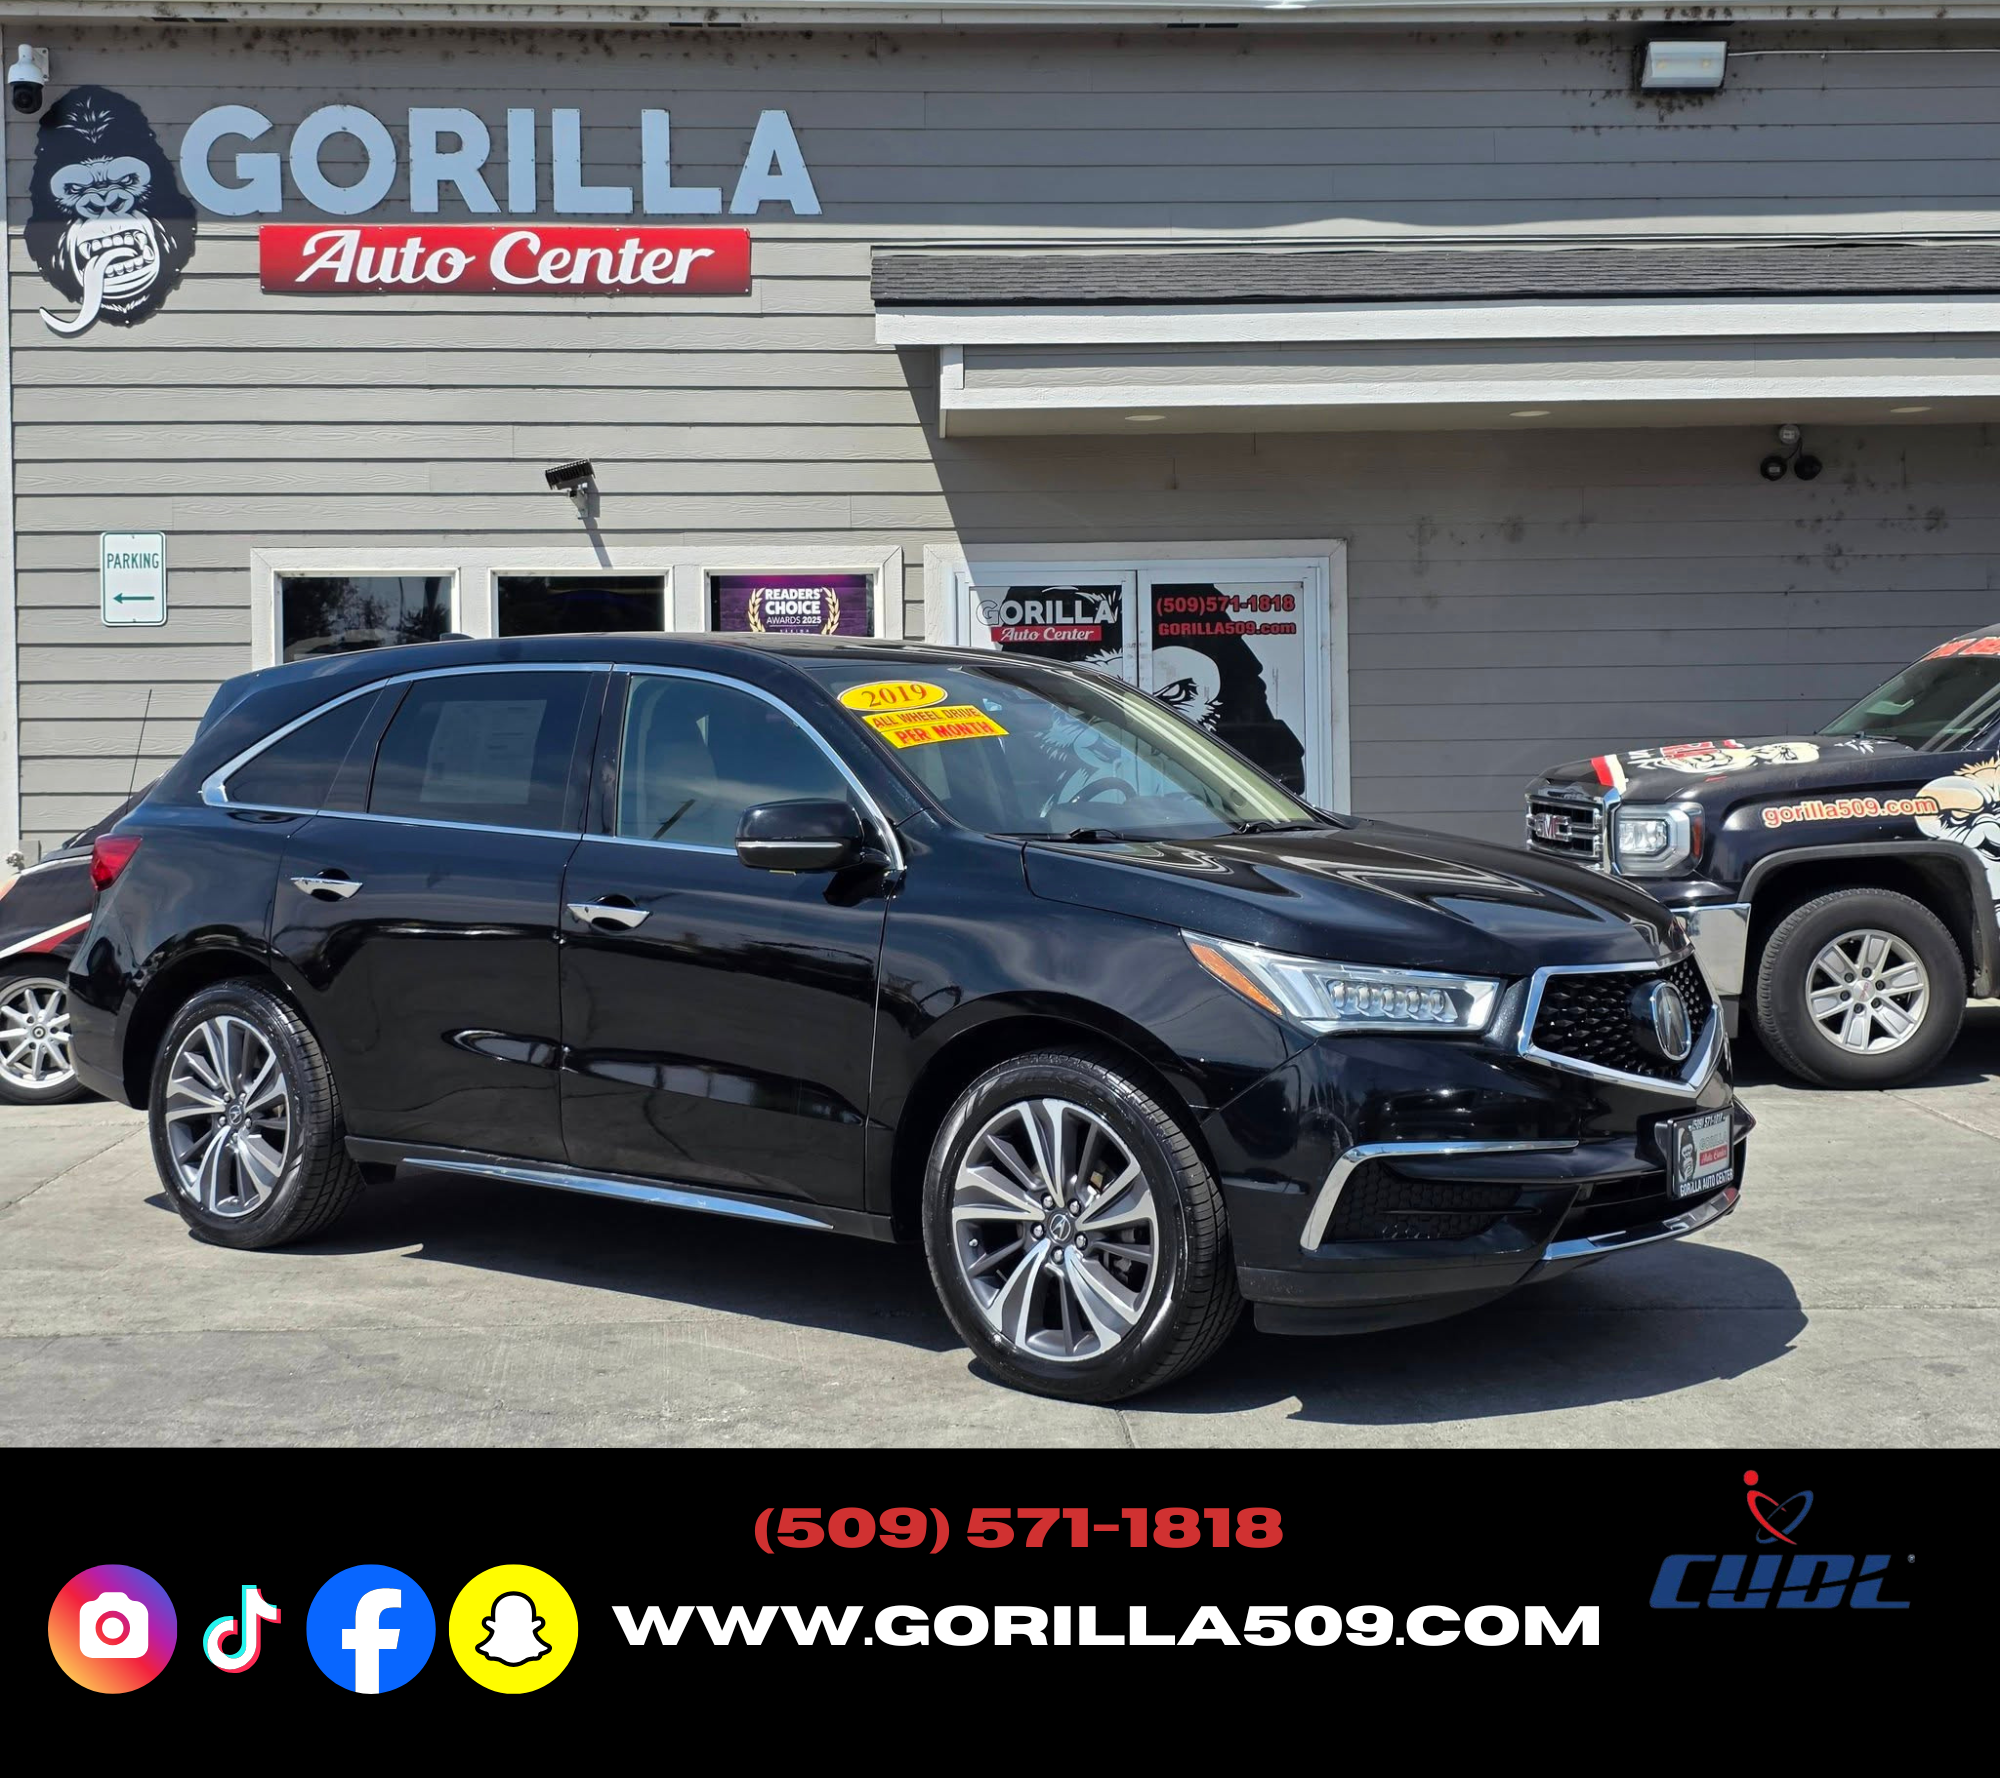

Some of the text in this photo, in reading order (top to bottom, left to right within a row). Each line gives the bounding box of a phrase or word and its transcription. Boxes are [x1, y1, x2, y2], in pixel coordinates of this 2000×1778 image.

[180, 105, 823, 216] GORILLA
[295, 229, 716, 285] Auto Center
[106, 553, 159, 569] PARKING
[765, 588, 823, 600] READERS'
[1156, 594, 1296, 616] (509)571-1818
[765, 601, 821, 615] CHOICE
[976, 600, 1115, 626] GORILLA
[766, 616, 822, 624] AWARDS 2025
[1158, 621, 1297, 636] GORILLA509.com
[1000, 627, 1094, 641] Auto Center
[861, 684, 928, 708] 2019
[872, 708, 980, 729] ALL WHEEL DRIVE
[894, 721, 995, 745] PER MONTH
[1763, 797, 1939, 828] gorilla509.com
[1680, 1169, 1733, 1197] GORILLA AUTO CENTER
